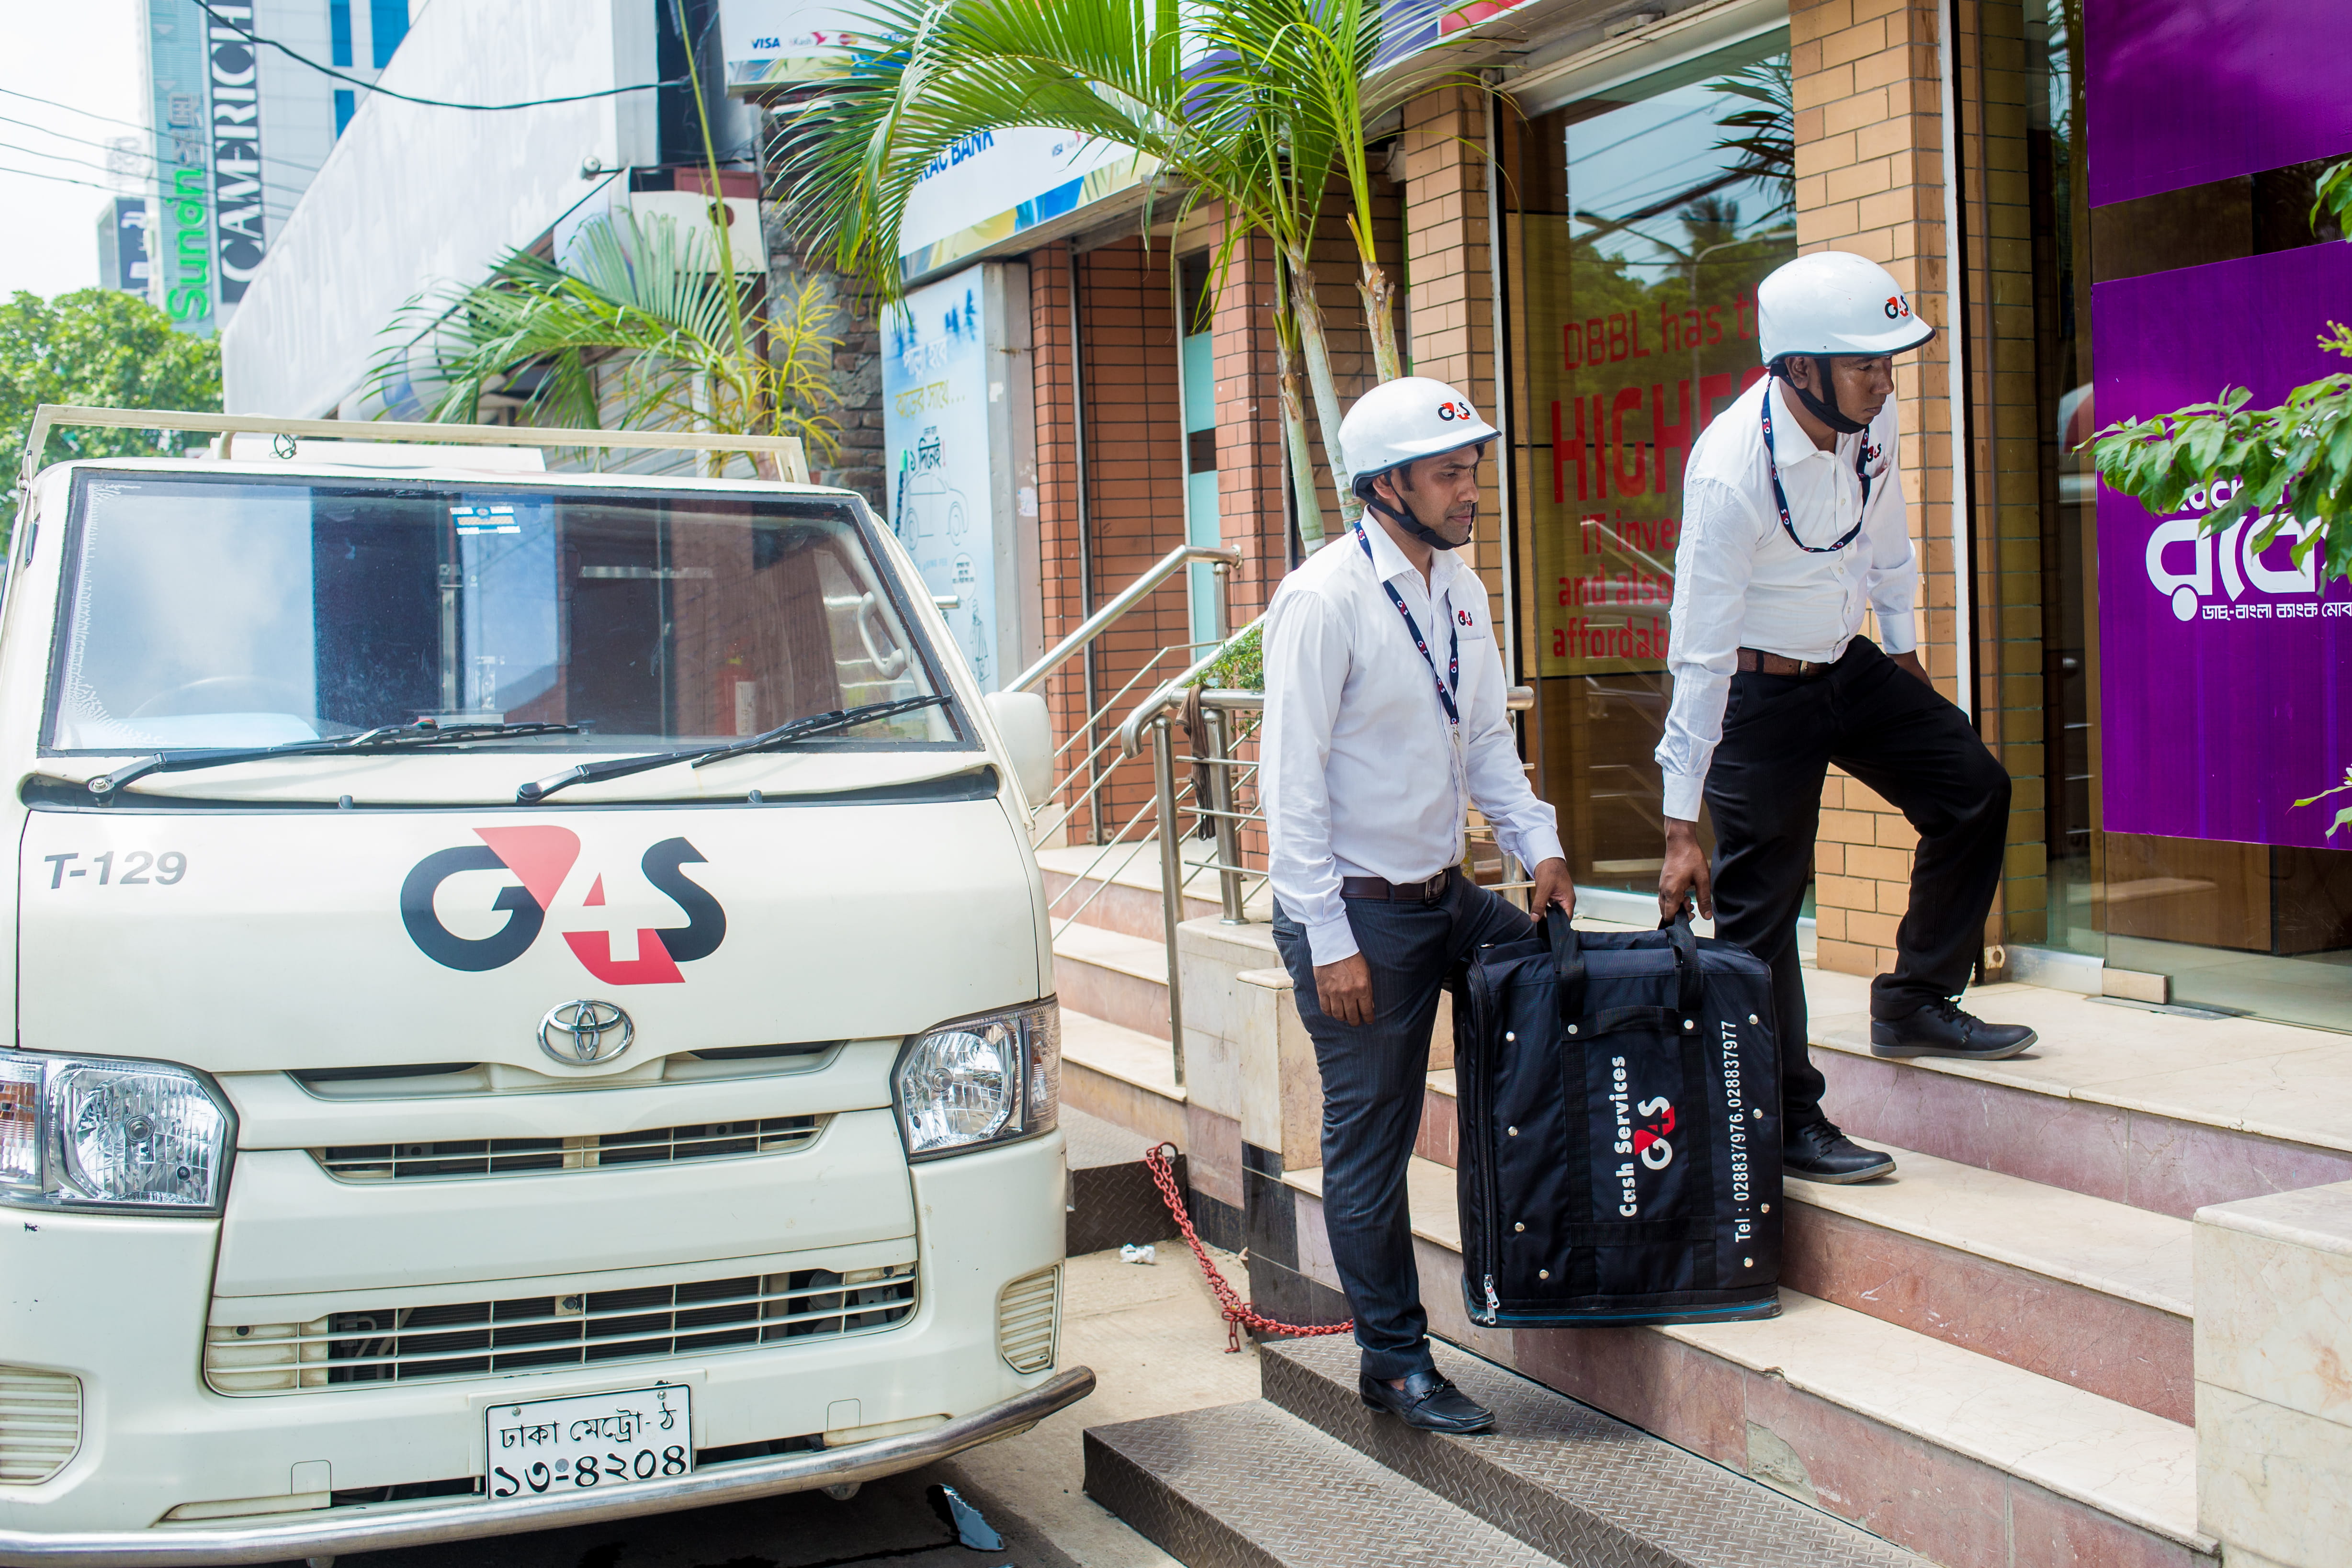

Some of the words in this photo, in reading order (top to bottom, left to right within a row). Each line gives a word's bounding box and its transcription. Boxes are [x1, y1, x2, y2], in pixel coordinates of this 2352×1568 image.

[751, 37, 781, 49] VISA
[208, 4, 263, 282] CAMERICH
[1563, 309, 1651, 371] DBBL
[1661, 302, 1723, 353] has
[1733, 282, 1760, 340] t
[1885, 294, 1909, 319] G4S
[1438, 401, 1471, 421] G4S
[1551, 365, 1769, 504] HIGH
[1582, 513, 1606, 554] IT
[1616, 509, 1683, 552] inve
[1558, 563, 1606, 606] and
[1615, 563, 1673, 605] also
[2276, 602, 2318, 619] ব্যাংক
[44, 850, 188, 890] T-129
[400, 824, 727, 986] G4S
[1609, 1056, 1633, 1154] Services
[1634, 1096, 1675, 1170] G4S
[1615, 1162, 1638, 1218] Cash
[1735, 1218, 1751, 1243] Tel
[499, 1420, 560, 1448] ঢাকা
[494, 1445, 687, 1498] ১৩-৪২০৪
